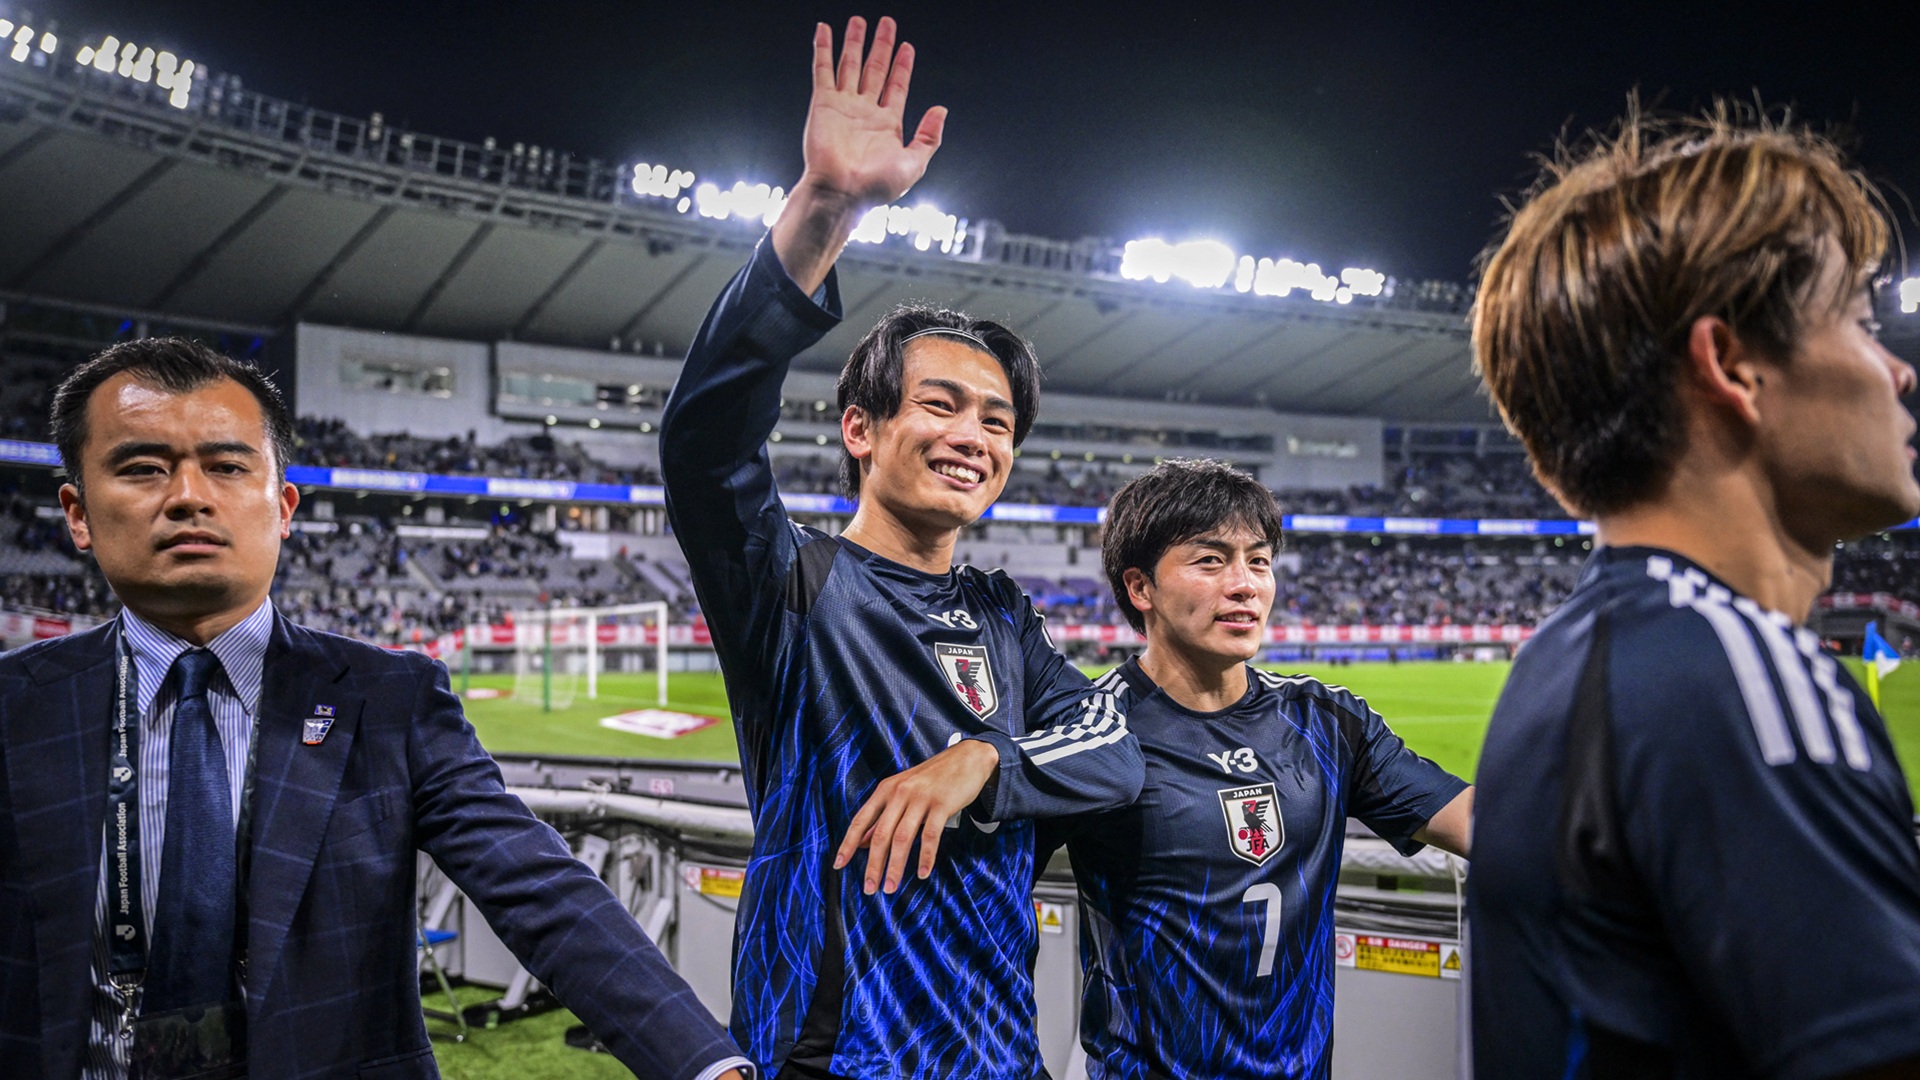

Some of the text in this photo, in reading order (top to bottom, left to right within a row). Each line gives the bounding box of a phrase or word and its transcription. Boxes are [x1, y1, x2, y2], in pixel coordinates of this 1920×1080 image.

[927, 609, 978, 629] Y-3
[948, 647, 974, 656] JAPAN
[118, 656, 129, 758] Japan Football Association
[1207, 747, 1258, 774] Y-3
[1233, 788, 1262, 798] JAPAN
[1246, 838, 1270, 852] JFA
[116, 802, 130, 915] Japan Football Association
[1242, 882, 1282, 977] 7
